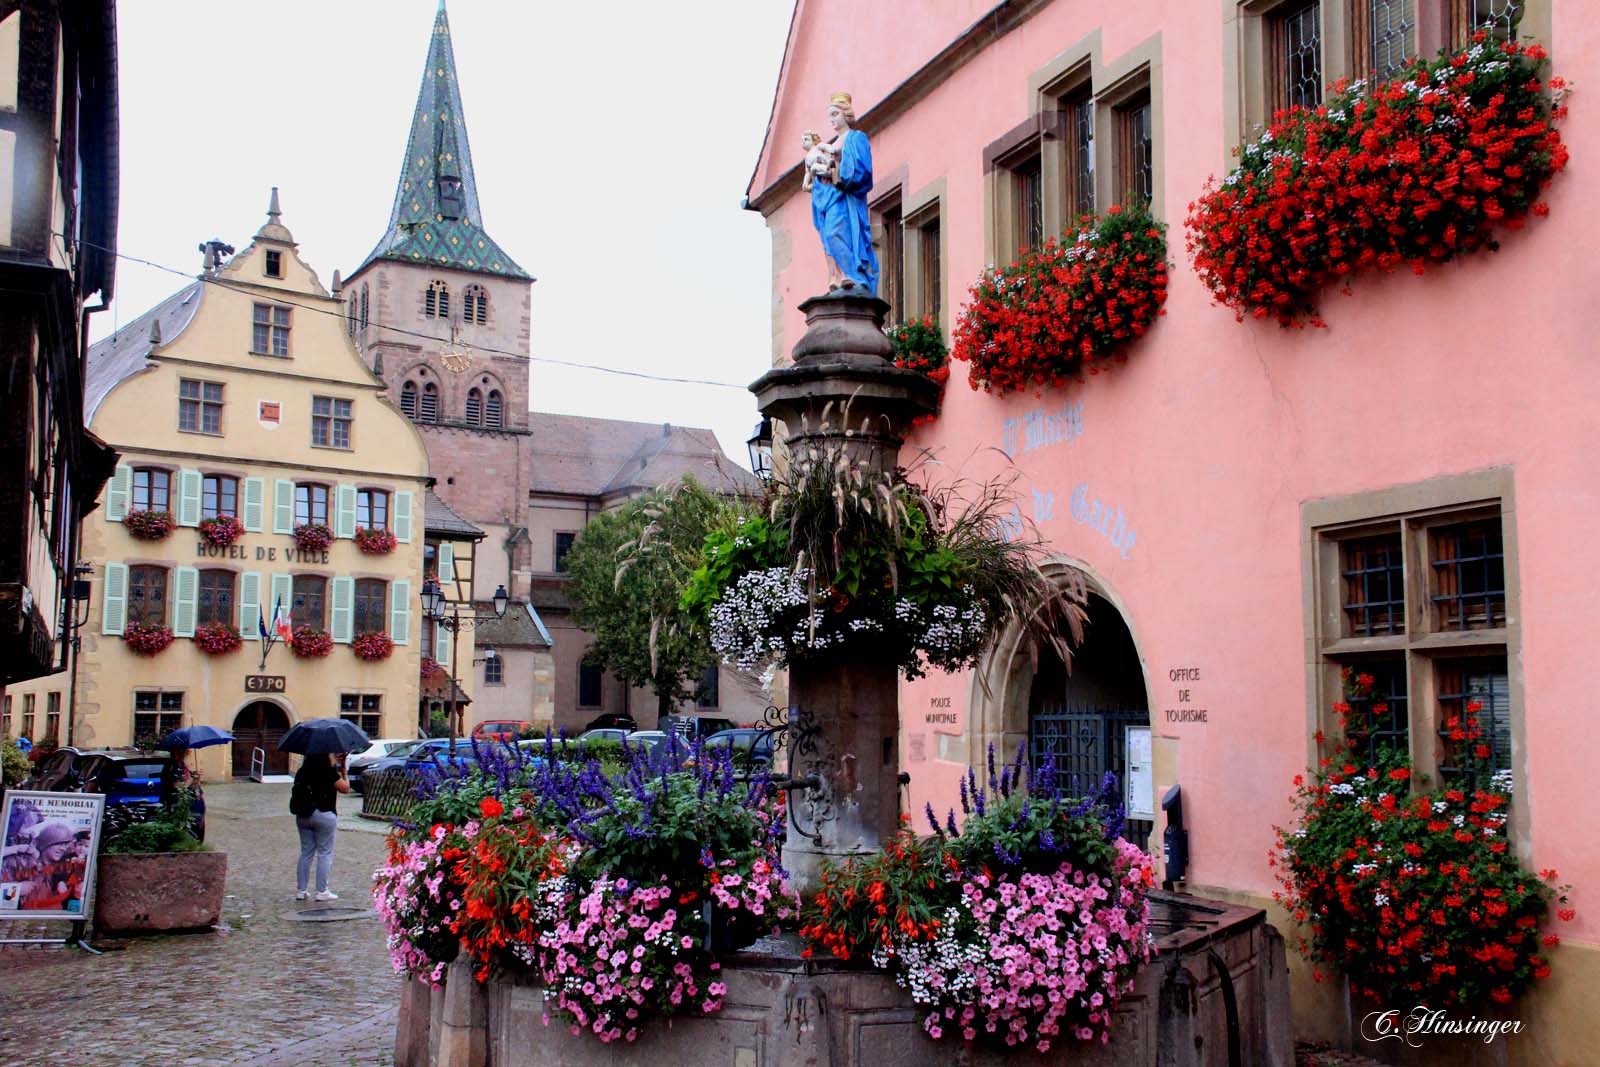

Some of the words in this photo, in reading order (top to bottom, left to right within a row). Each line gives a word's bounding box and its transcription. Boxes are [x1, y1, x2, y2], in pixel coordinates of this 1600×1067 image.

[1071, 481, 1137, 560] Garde
[256, 547, 277, 561] DE
[285, 548, 330, 564] VILLE
[1169, 668, 1201, 682] OFFICE
[1178, 689, 1191, 702] DE
[930, 697, 951, 708] POLICE
[925, 713, 957, 724] MUNICIPALE
[1165, 710, 1208, 723] TOURISME
